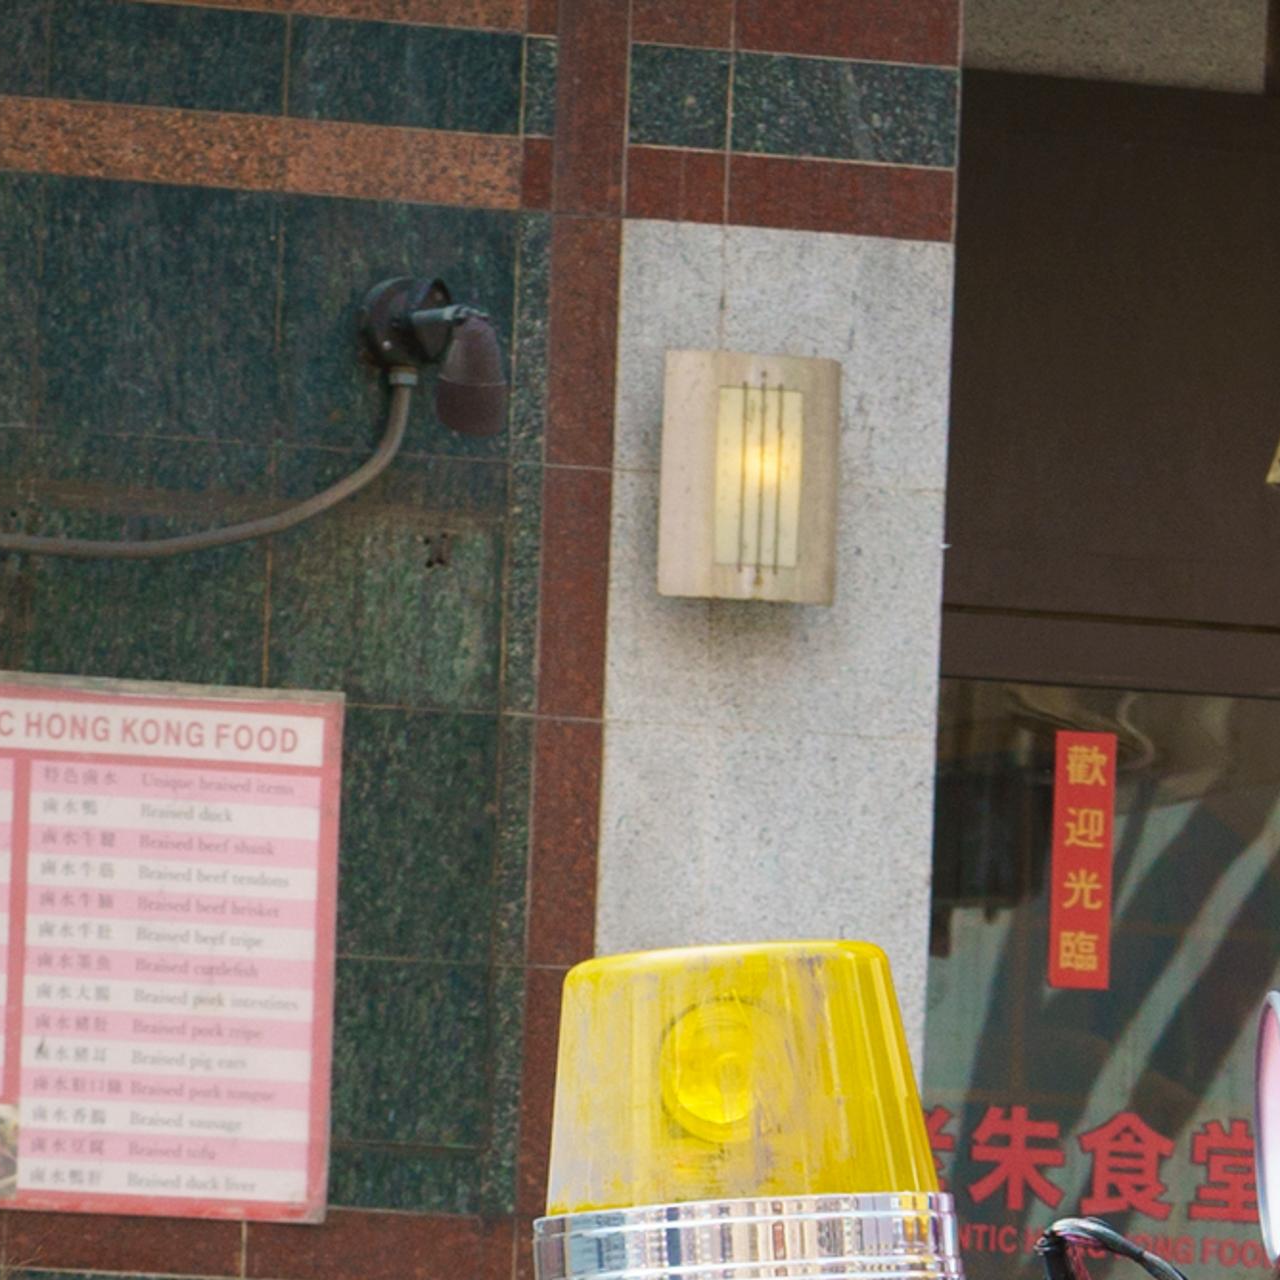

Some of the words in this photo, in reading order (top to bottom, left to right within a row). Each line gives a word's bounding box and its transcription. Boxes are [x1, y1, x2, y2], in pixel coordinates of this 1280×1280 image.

[24, 712, 111, 742] HONG
[121, 717, 205, 748] KONG
[214, 723, 299, 754] FOOD
[1058, 745, 1108, 972] 歡迎光臨
